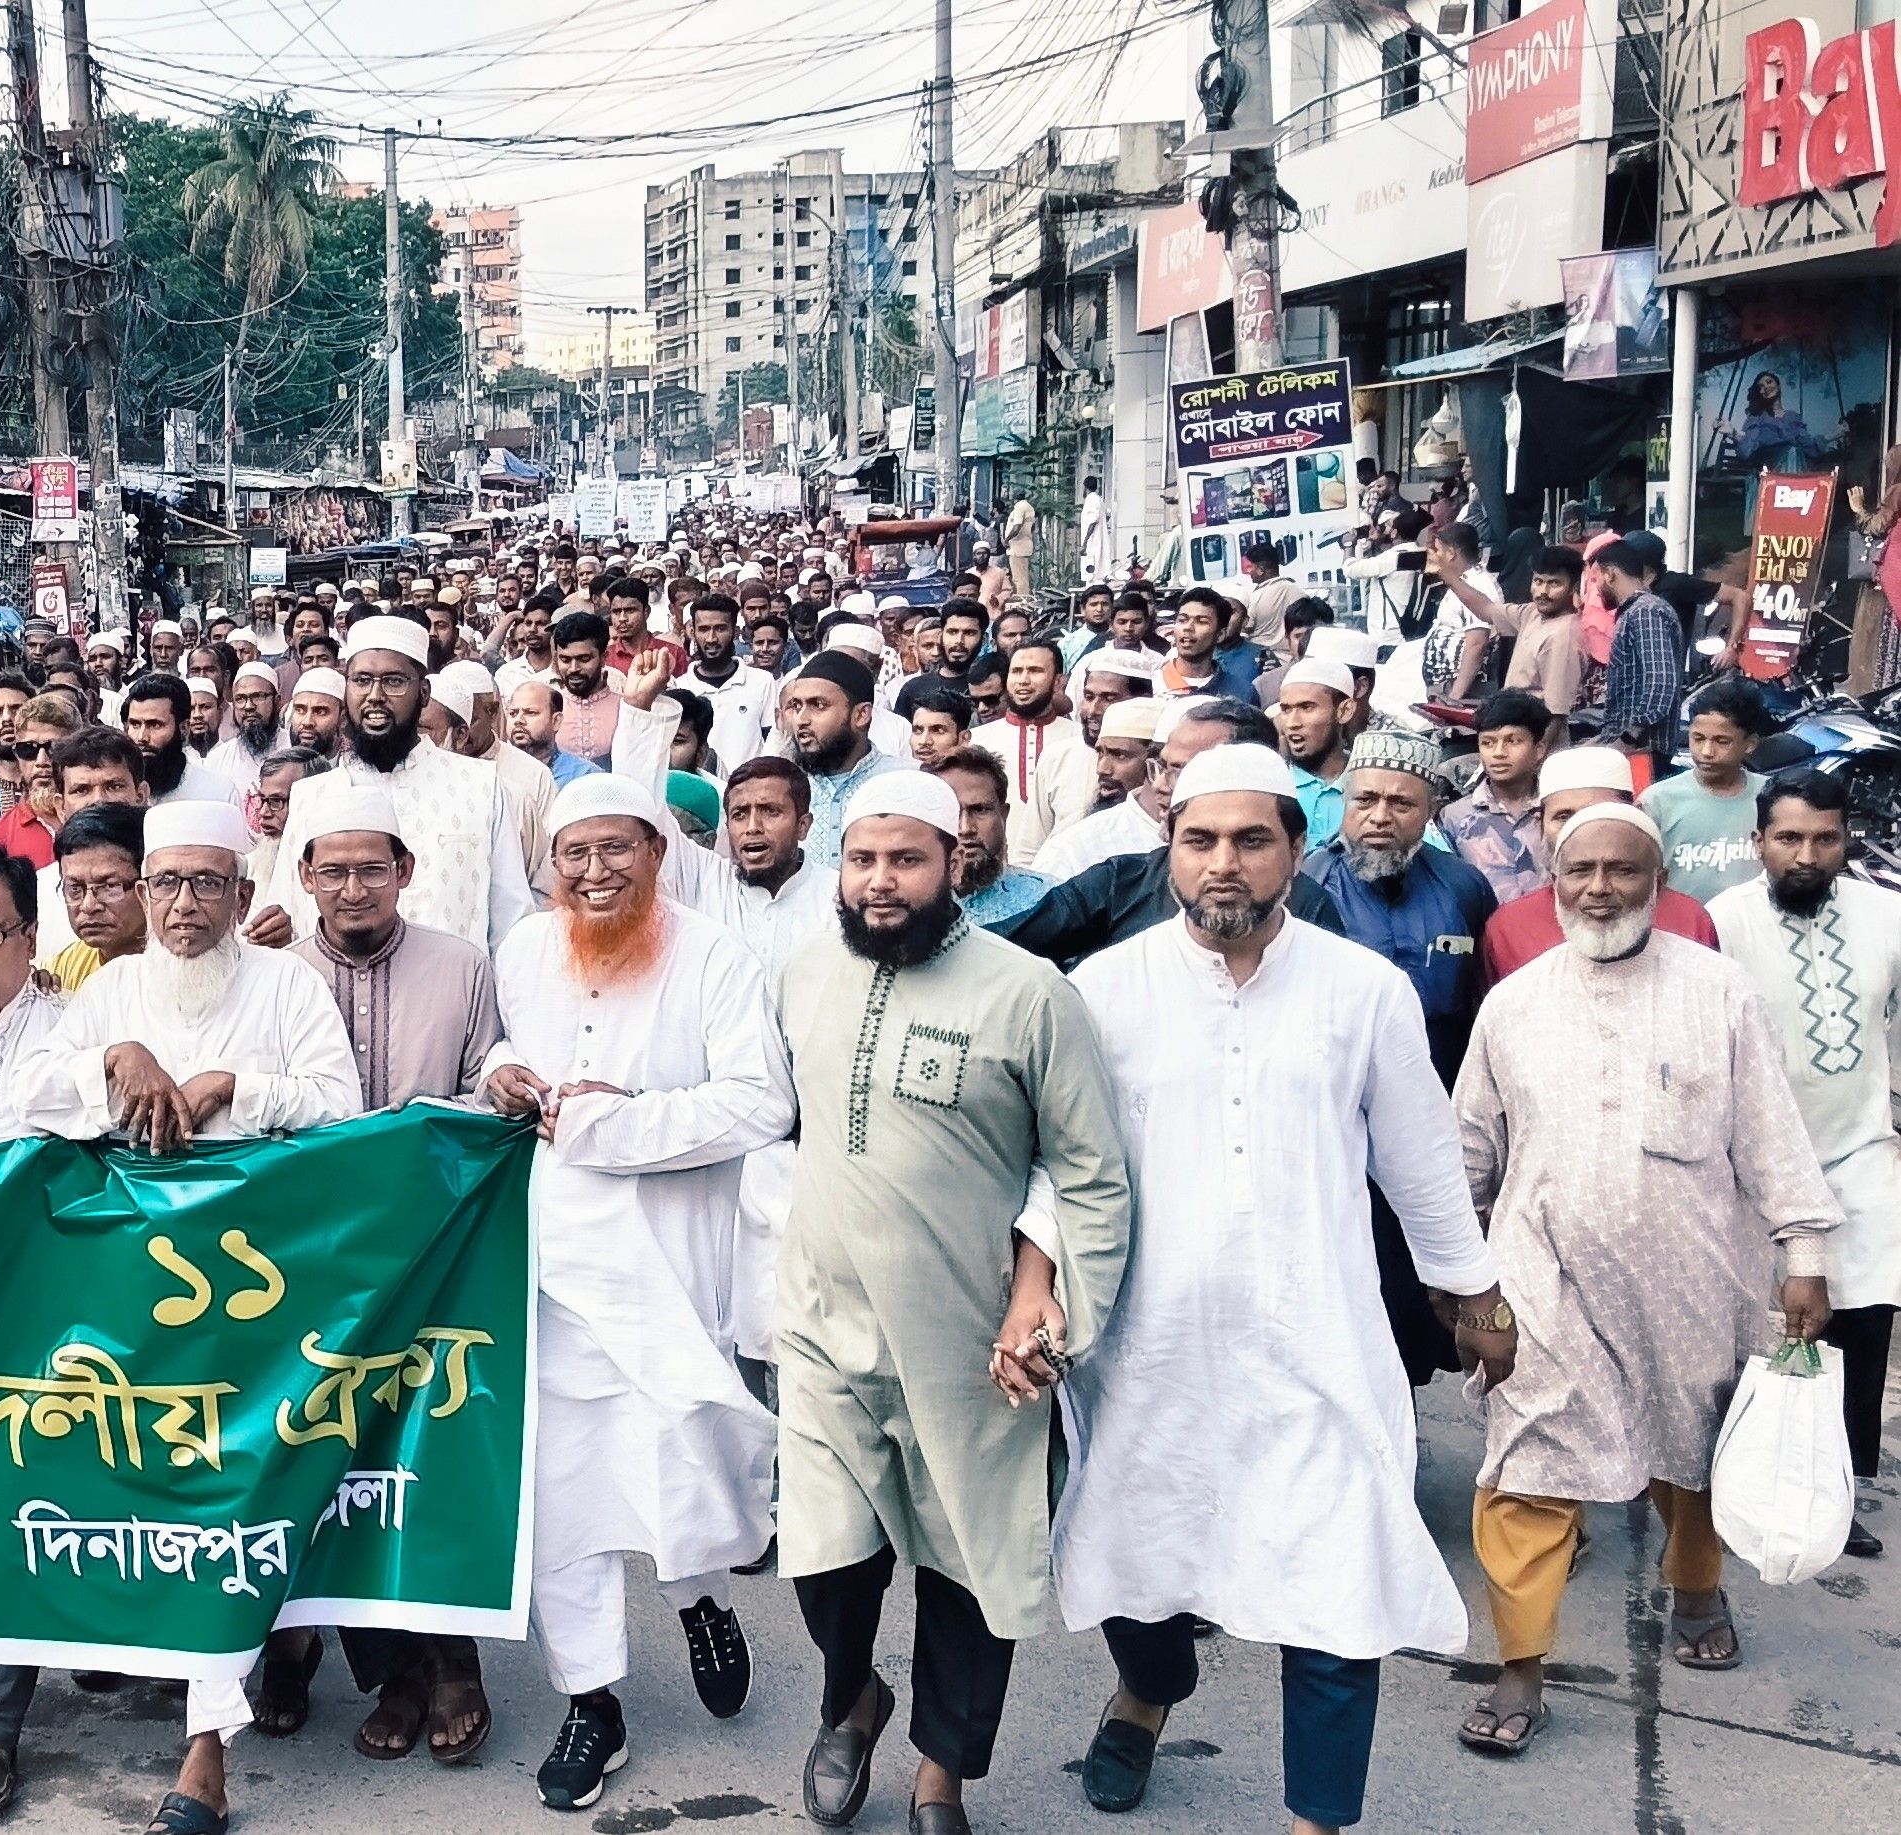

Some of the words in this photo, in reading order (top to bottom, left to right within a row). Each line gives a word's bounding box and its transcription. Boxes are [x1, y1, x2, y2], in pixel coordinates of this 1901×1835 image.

[1467, 14, 1575, 117] SYMPHONY
[1179, 379, 1250, 409] রোশনী
[1256, 370, 1340, 398] টেলিকম
[1179, 408, 1212, 422] এখানে
[1180, 409, 1277, 445] মোবাইল
[1284, 401, 1343, 430] ফোন
[1773, 485, 1818, 516] Bay
[1756, 534, 1817, 559] ENJOY
[1754, 557, 1786, 582] Eid
[146, 1228, 288, 1328] ১১
[11, 1500, 296, 1599] দিনাজপুর
